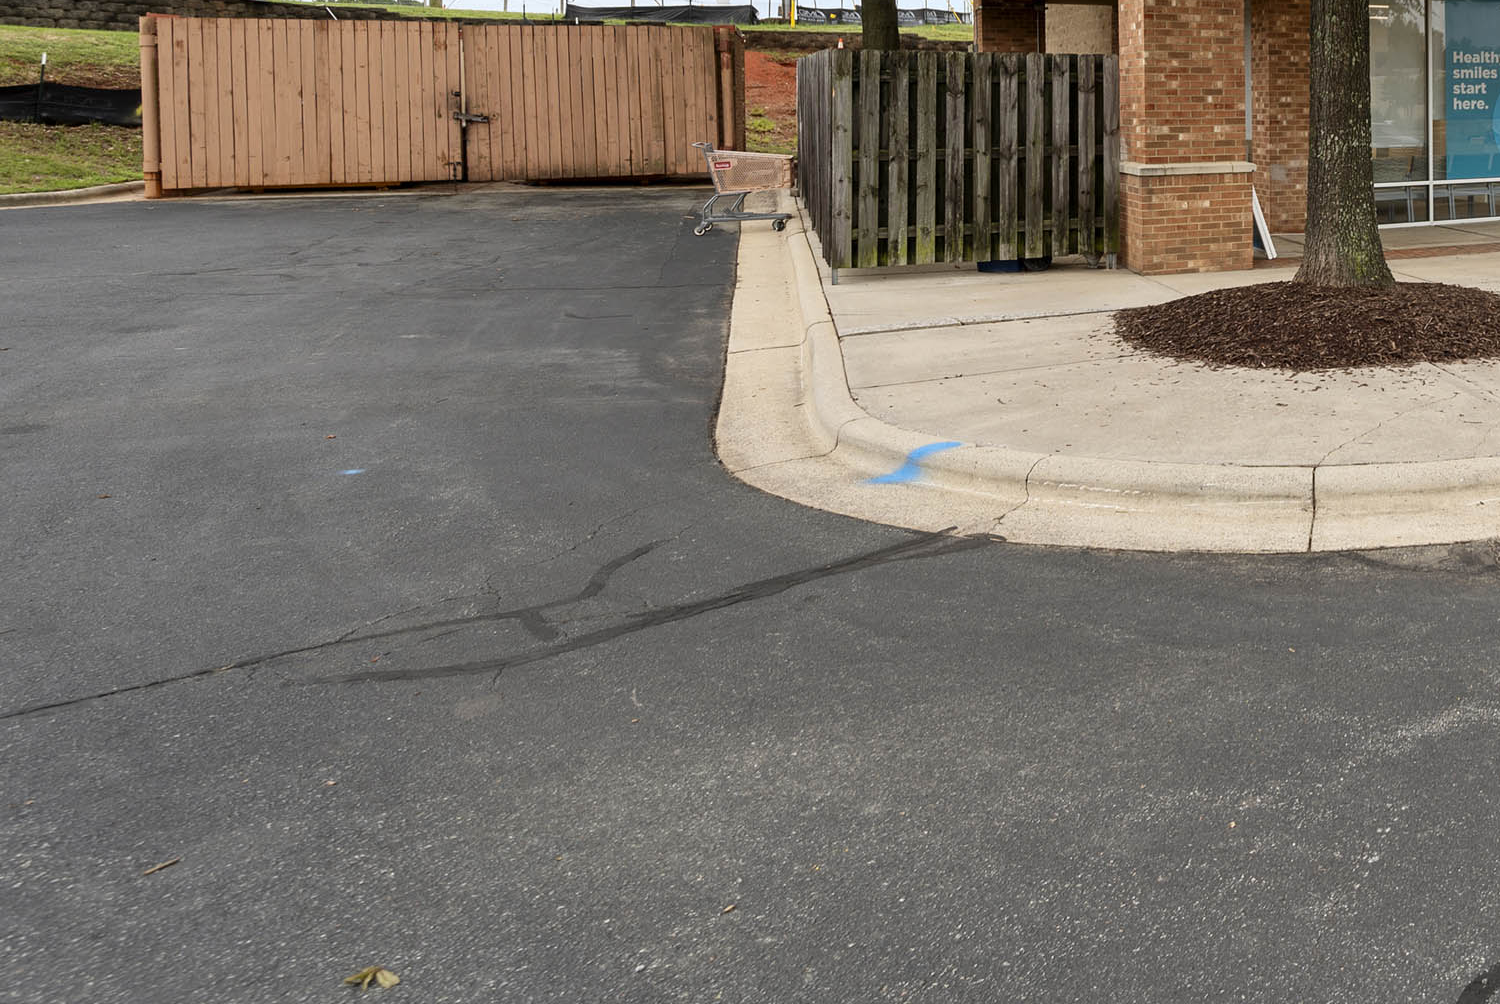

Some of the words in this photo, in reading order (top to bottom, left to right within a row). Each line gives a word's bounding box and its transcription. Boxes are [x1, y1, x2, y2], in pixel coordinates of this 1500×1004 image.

[1453, 66, 1498, 79] smiles
[1453, 82, 1487, 94] start
[1453, 97, 1489, 110] here.
